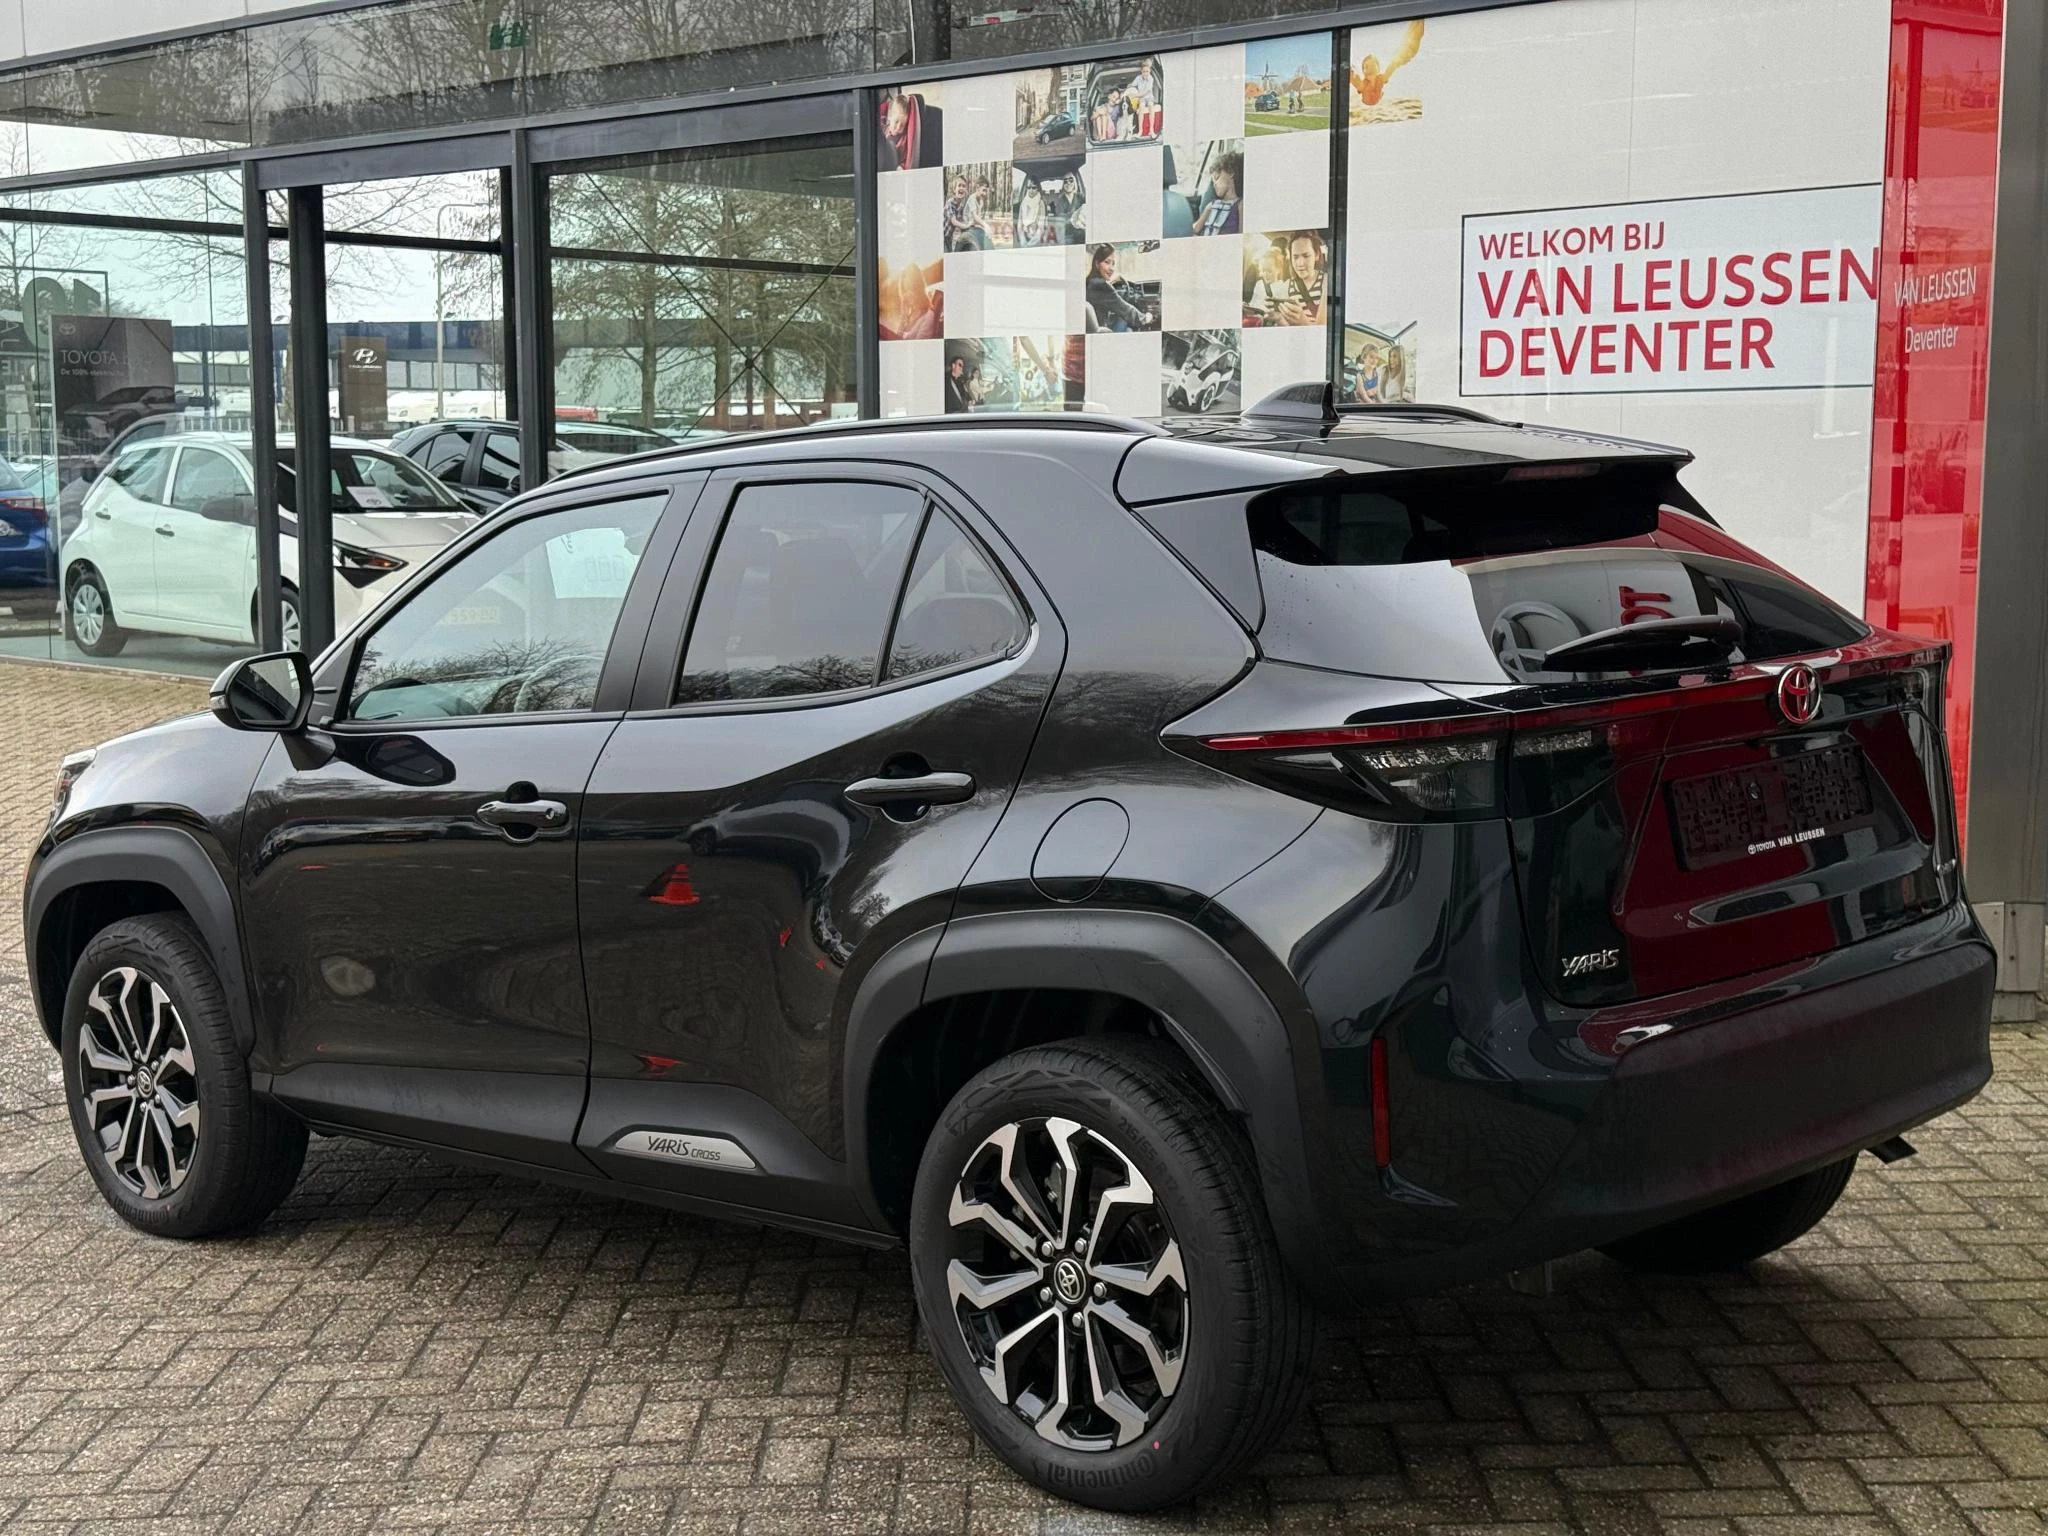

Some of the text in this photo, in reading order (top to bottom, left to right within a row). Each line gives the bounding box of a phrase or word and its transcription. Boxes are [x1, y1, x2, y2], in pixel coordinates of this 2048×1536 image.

[1478, 221, 1666, 260] WELKOM BIJ
[1478, 246, 1880, 320] VAN LEUSSEN
[1895, 266, 1977, 307] VAN LEUSSEN
[1478, 317, 1776, 378] DEVENTER
[1904, 323, 1959, 353] Deventer
[59, 349, 120, 366] TOYOTA
[1756, 827, 1826, 852] TOYOTA VAN LEUSSEN
[691, 1148, 721, 1161] CROSS
